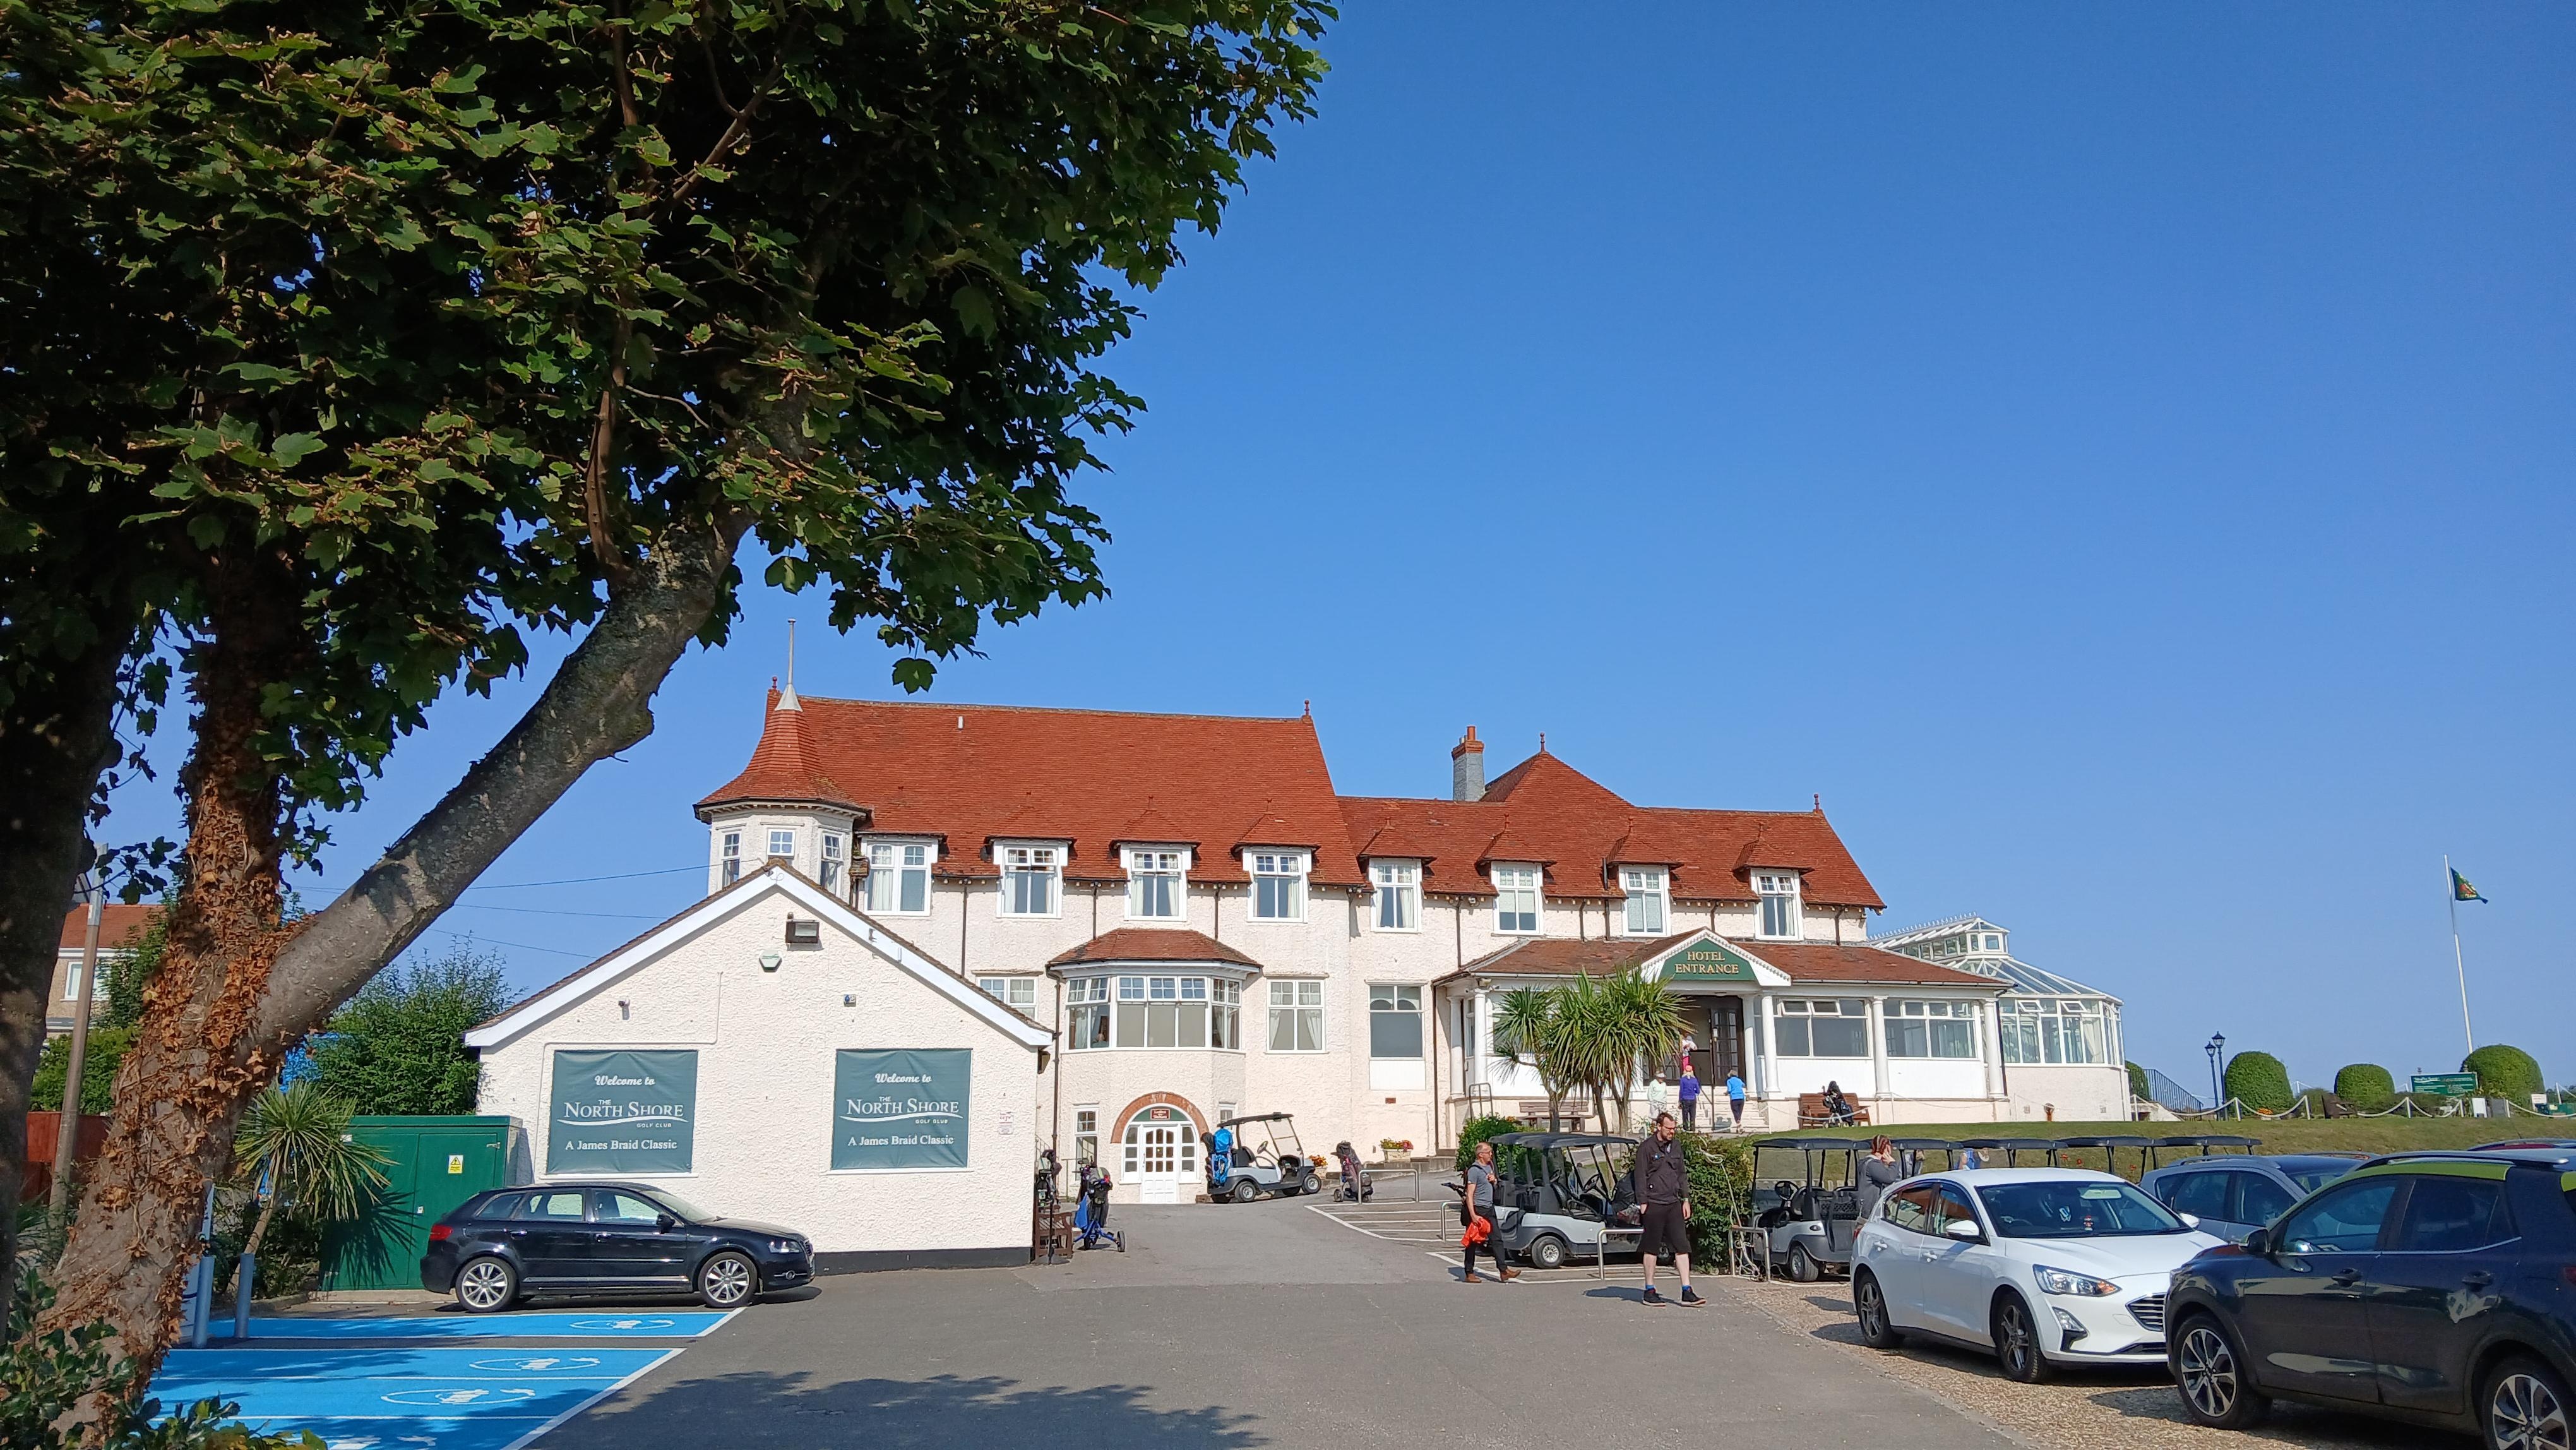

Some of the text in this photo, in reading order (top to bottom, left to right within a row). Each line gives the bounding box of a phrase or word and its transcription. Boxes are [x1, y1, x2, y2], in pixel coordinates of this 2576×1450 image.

[1687, 951, 1726, 961] HOTEL
[1674, 964, 1739, 974] ENTRANCE
[595, 1075, 655, 1086] Welcome to
[875, 1073, 932, 1083] Welcome to
[564, 1101, 683, 1118] NORTH SHORE
[847, 1098, 959, 1115] NORTH SHORE
[565, 1139, 677, 1150] A James Braid Classic
[848, 1135, 953, 1146] A James Braid Classic
